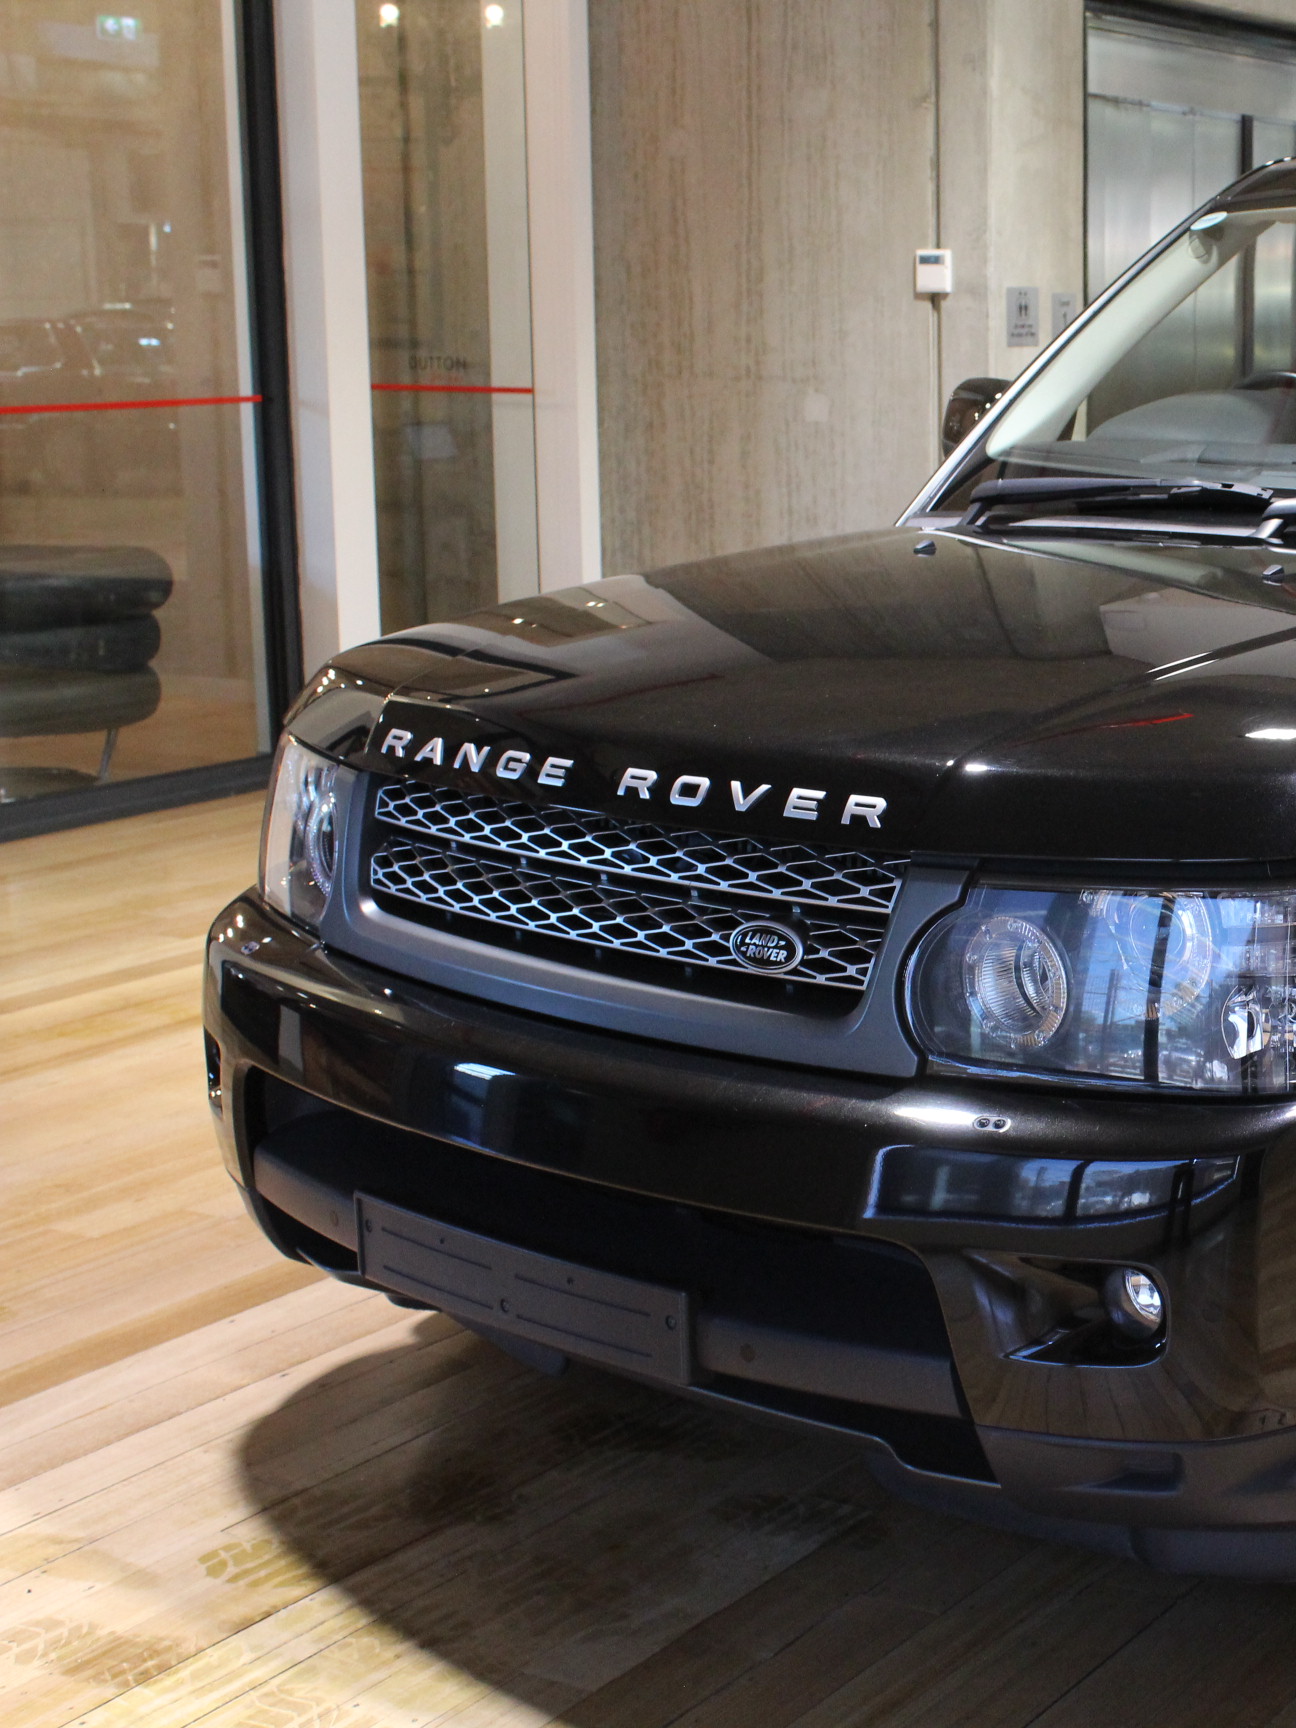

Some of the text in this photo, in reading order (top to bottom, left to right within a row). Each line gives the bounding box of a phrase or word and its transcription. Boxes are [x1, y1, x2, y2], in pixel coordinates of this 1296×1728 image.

[381, 727, 889, 829] RANGE ROVER
[745, 931, 779, 947] LAND
[746, 945, 788, 962] ROVER
